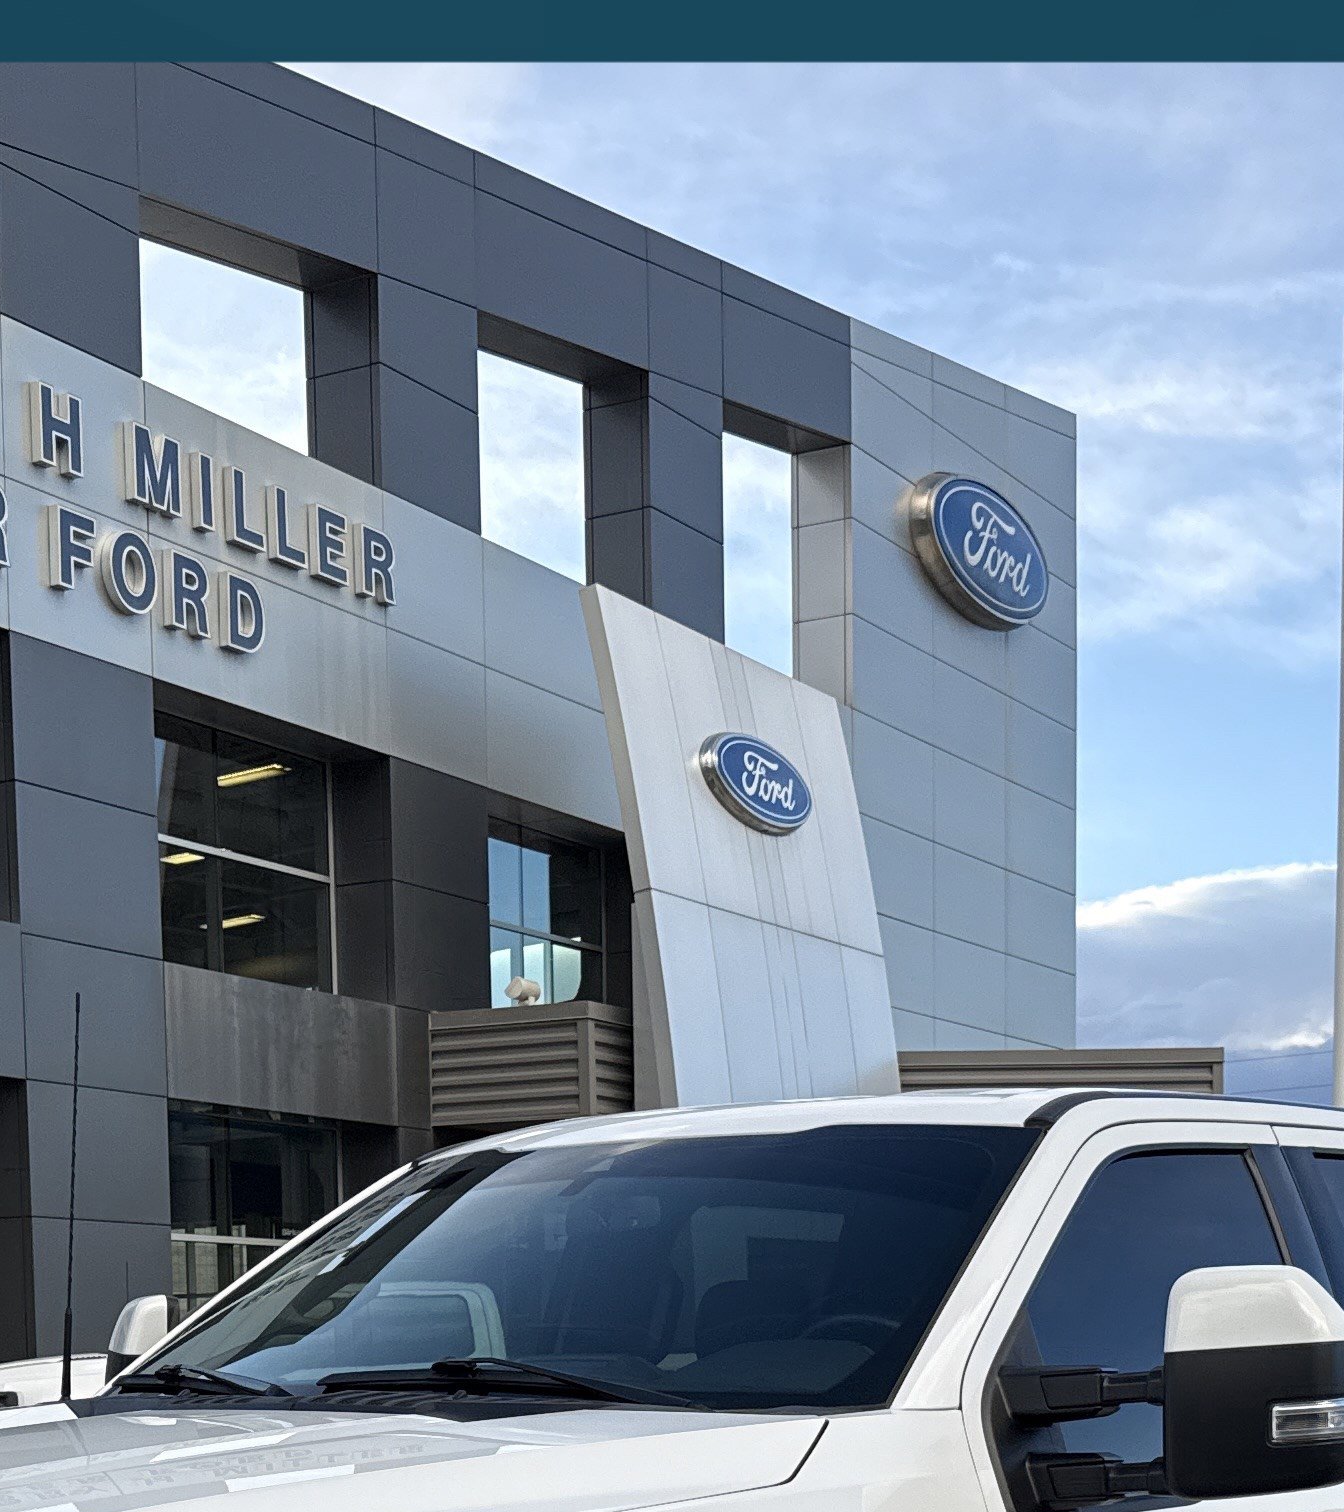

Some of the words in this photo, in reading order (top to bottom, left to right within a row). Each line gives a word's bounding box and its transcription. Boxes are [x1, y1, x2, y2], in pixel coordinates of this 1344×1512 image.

[29, 380, 84, 479] H
[123, 421, 397, 607] MILLER
[962, 500, 1032, 599] Ford
[47, 502, 265, 655] FORD
[740, 751, 797, 812] Ford
